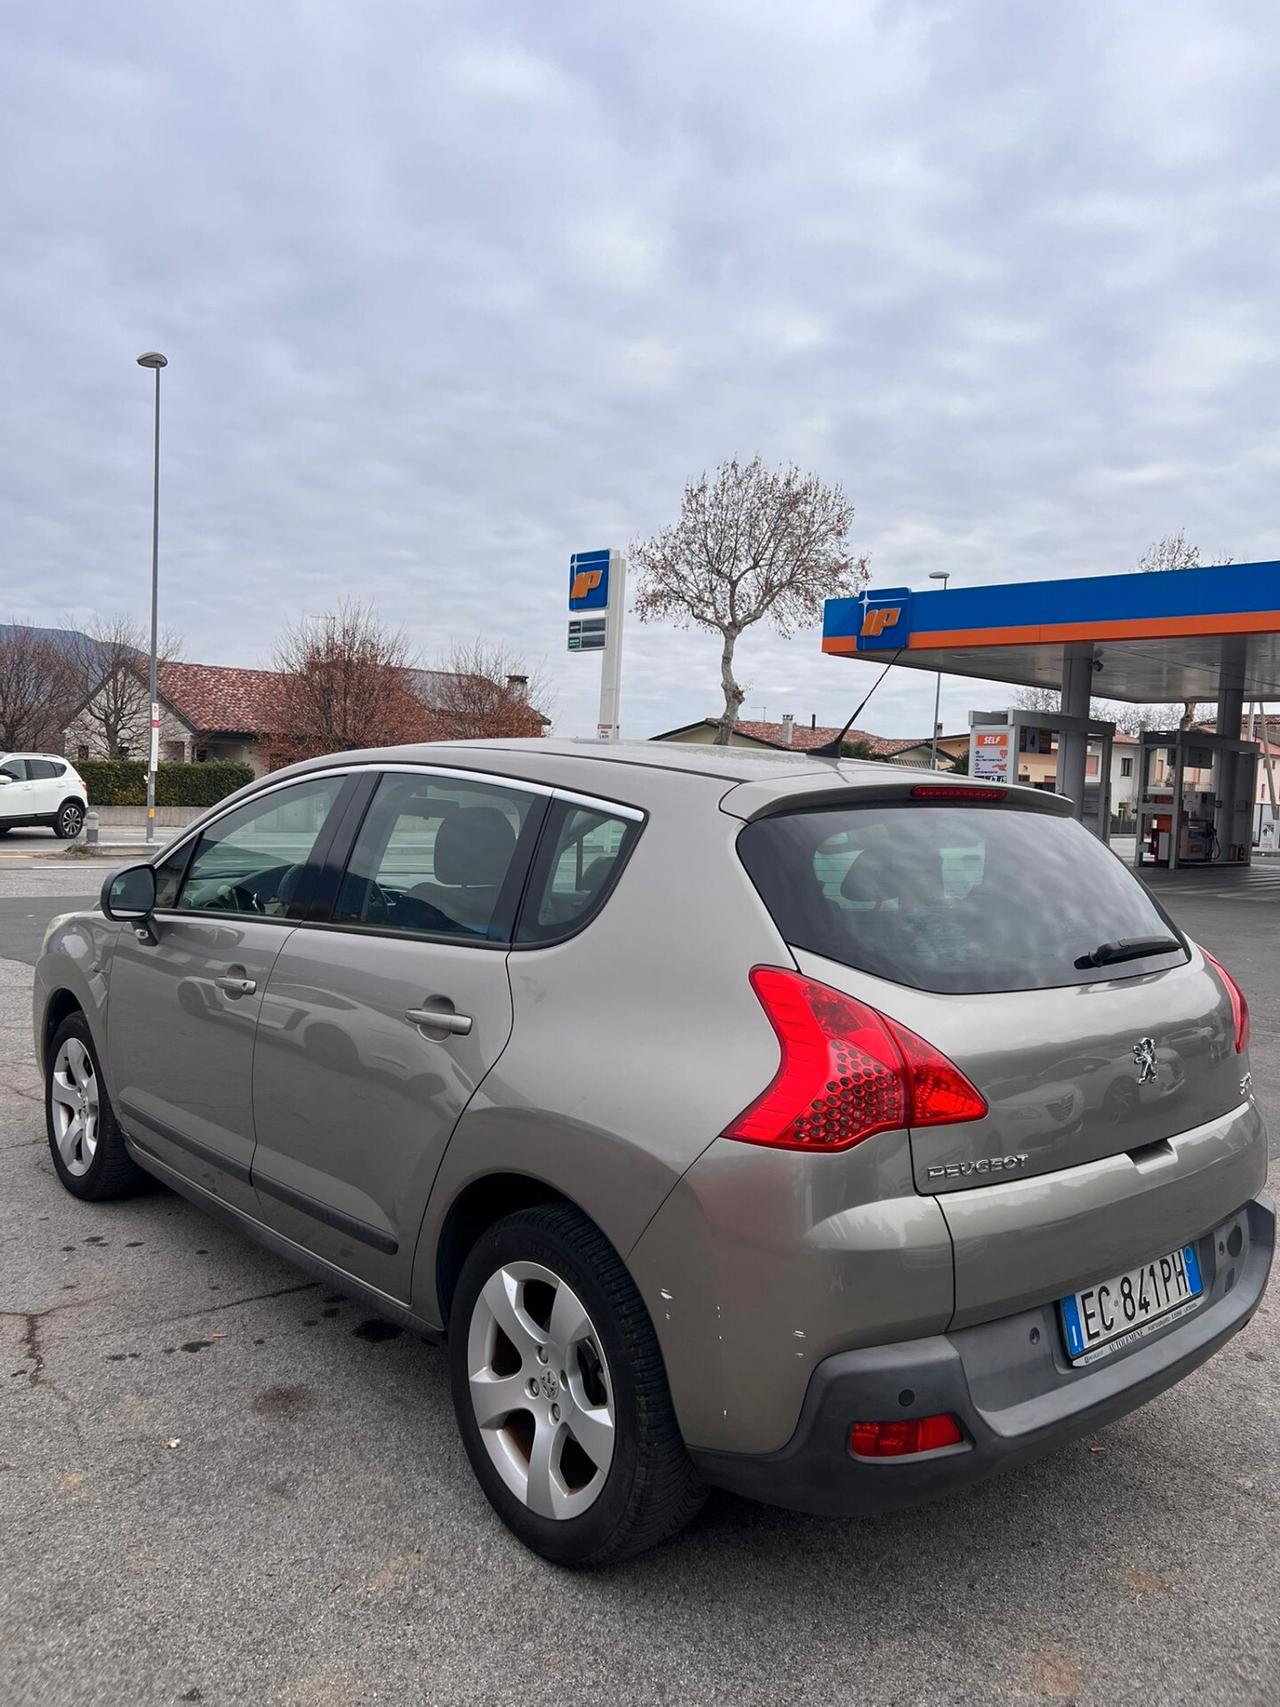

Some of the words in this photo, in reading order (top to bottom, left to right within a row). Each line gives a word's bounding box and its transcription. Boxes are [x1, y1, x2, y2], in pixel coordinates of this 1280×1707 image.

[861, 608, 901, 636] IP
[983, 736, 1001, 744] SELF
[928, 1154, 1029, 1180] PEUGEOT
[1081, 1286, 1114, 1340] EC
[1120, 1251, 1188, 1321] 841PH
